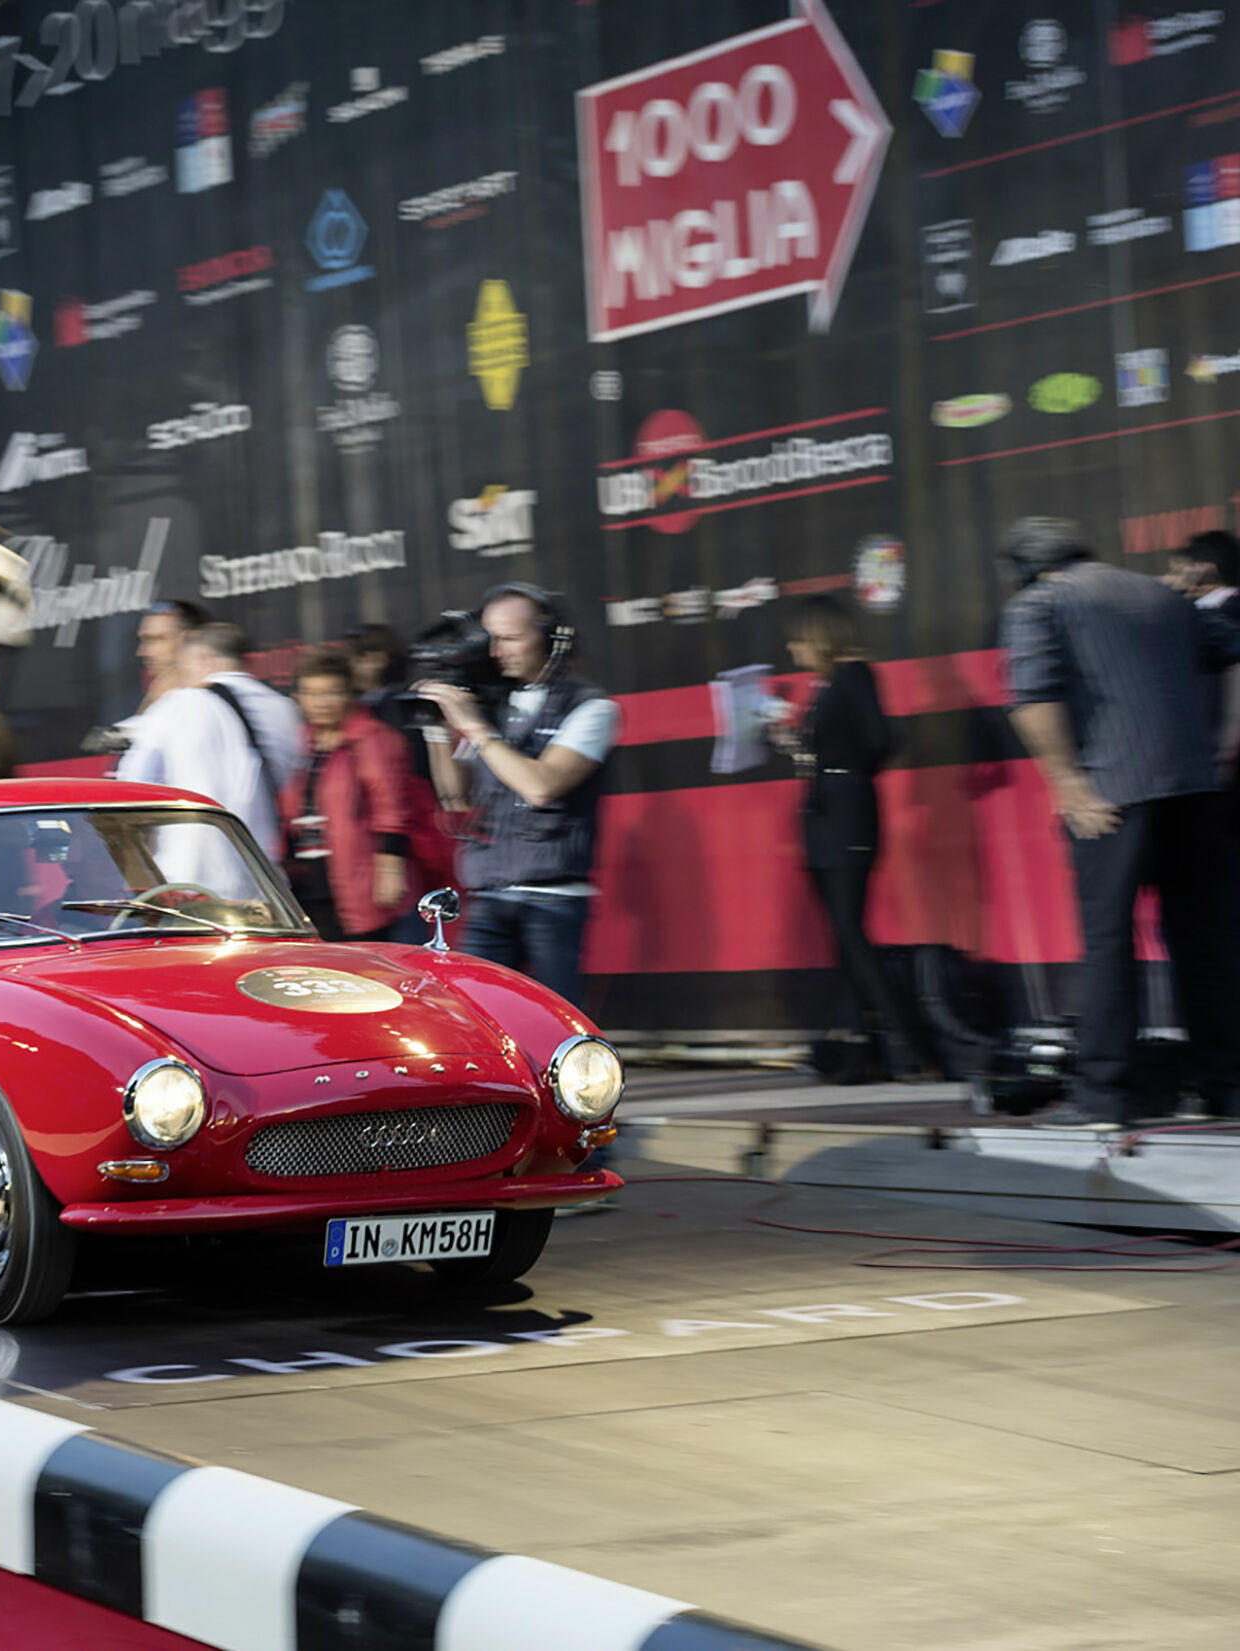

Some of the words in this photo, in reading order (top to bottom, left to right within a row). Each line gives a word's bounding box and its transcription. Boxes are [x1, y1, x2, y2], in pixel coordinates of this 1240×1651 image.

[605, 64, 797, 187] 1000
[604, 180, 818, 308] MIGLIA
[314, 1062, 479, 1084] MONZA
[346, 1224, 382, 1259] IN
[104, 1292, 1026, 1385] CHOPARD
